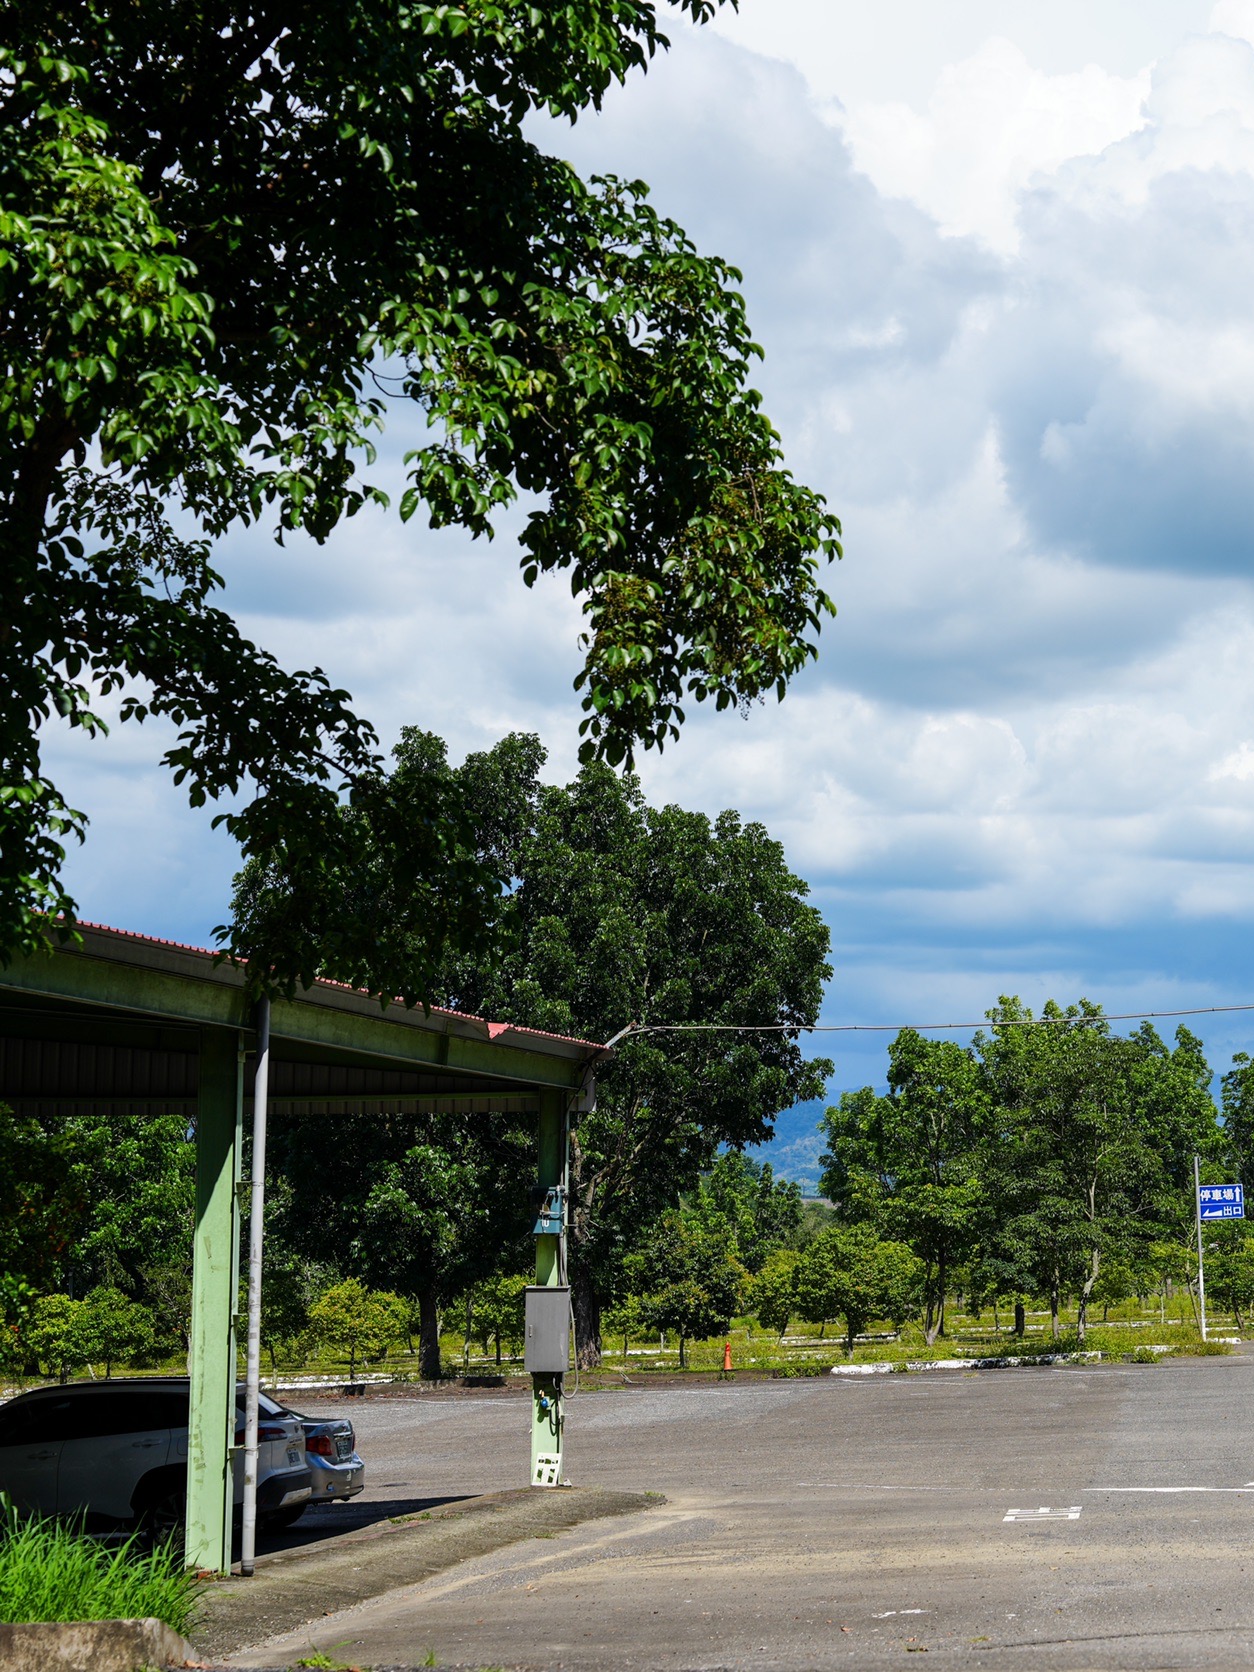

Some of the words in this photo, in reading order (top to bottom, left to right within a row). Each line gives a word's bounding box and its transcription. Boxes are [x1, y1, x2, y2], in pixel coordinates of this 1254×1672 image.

[1201, 1188, 1235, 1202] 停車場
[1223, 1205, 1242, 1216] 出口
